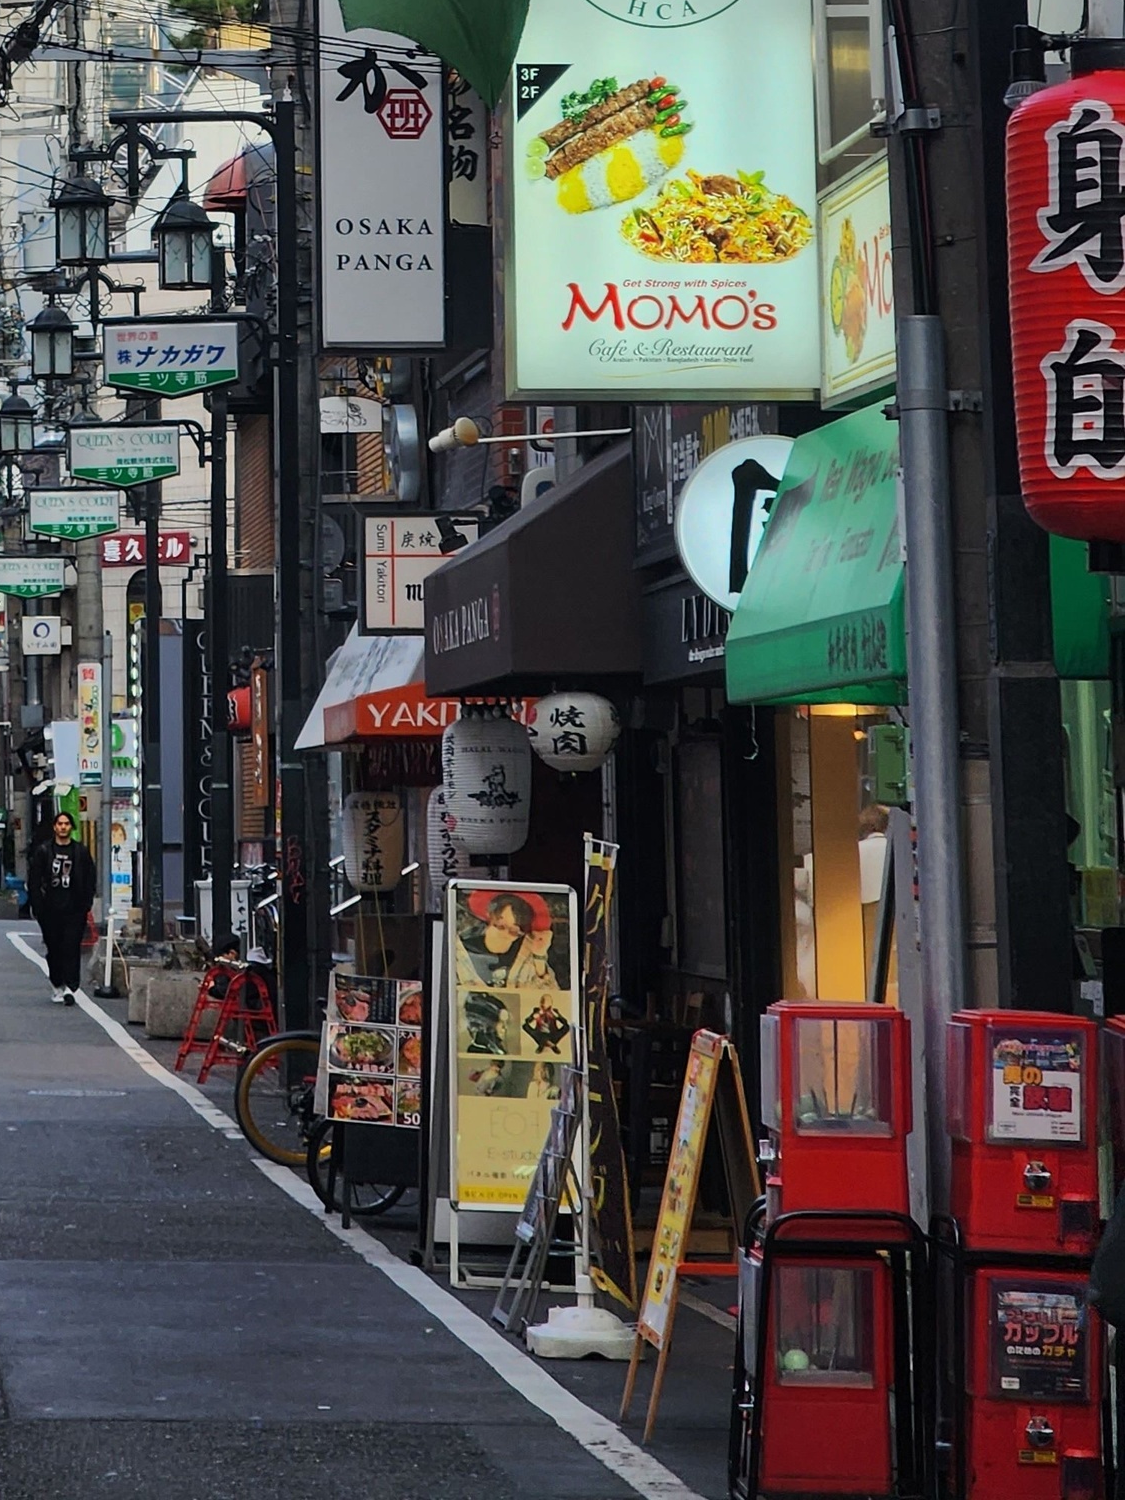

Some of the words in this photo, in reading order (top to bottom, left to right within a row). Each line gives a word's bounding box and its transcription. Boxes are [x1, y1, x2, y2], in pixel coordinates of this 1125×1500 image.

[521, 69, 539, 81] 3F
[521, 86, 539, 99] 2F
[336, 218, 433, 236] OSAKA
[336, 254, 434, 271] PANGA
[622, 279, 643, 289] Get
[645, 279, 681, 290] Strong
[683, 279, 708, 288] with
[710, 279, 747, 290] Spices
[652, 338, 753, 357] Restaurant
[138, 371, 207, 387] 三ツ寺筋
[130, 431, 174, 447] COURT
[98, 467, 154, 480] 三ツ寺筋
[376, 524, 387, 552] Sumi
[103, 537, 184, 562] 喜久ル
[376, 561, 387, 603] Yakitori
[433, 609, 460, 655] OSAKA
[461, 597, 490, 645] PANGA
[550, 705, 588, 755] 焼肉
